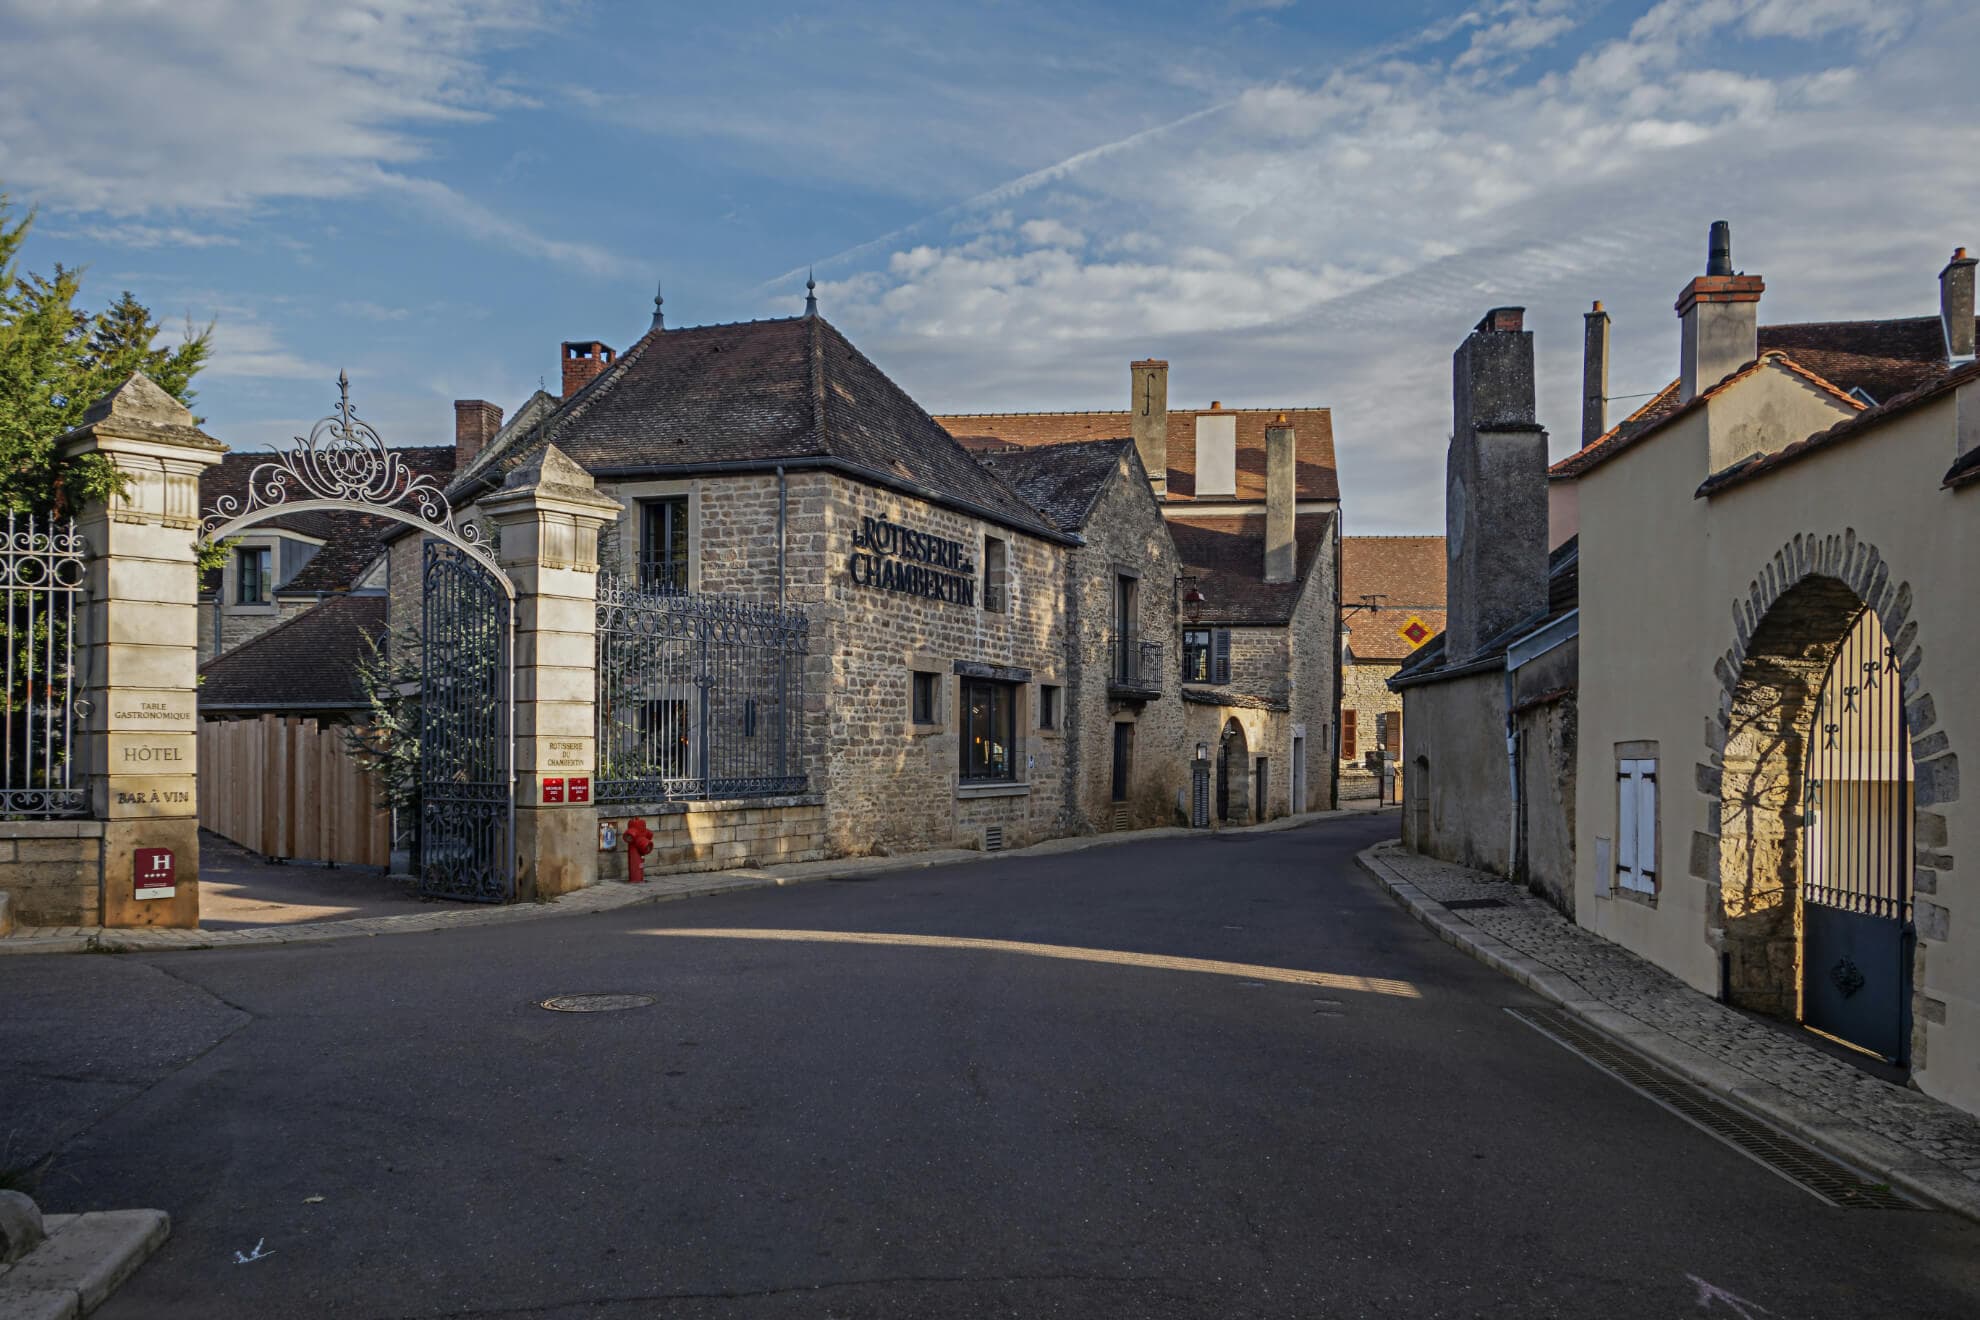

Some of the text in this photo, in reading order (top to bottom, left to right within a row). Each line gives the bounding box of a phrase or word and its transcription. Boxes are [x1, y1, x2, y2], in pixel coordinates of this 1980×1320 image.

[863, 512, 965, 570] RÔTISSERIE
[850, 552, 974, 607] CHAMBERTIN
[141, 703, 167, 711] TABLE
[114, 711, 191, 720] GASTRONOMIQUE
[124, 745, 183, 761] HÔTEL
[117, 788, 189, 804] BAR À VIN
[152, 854, 171, 870] H
